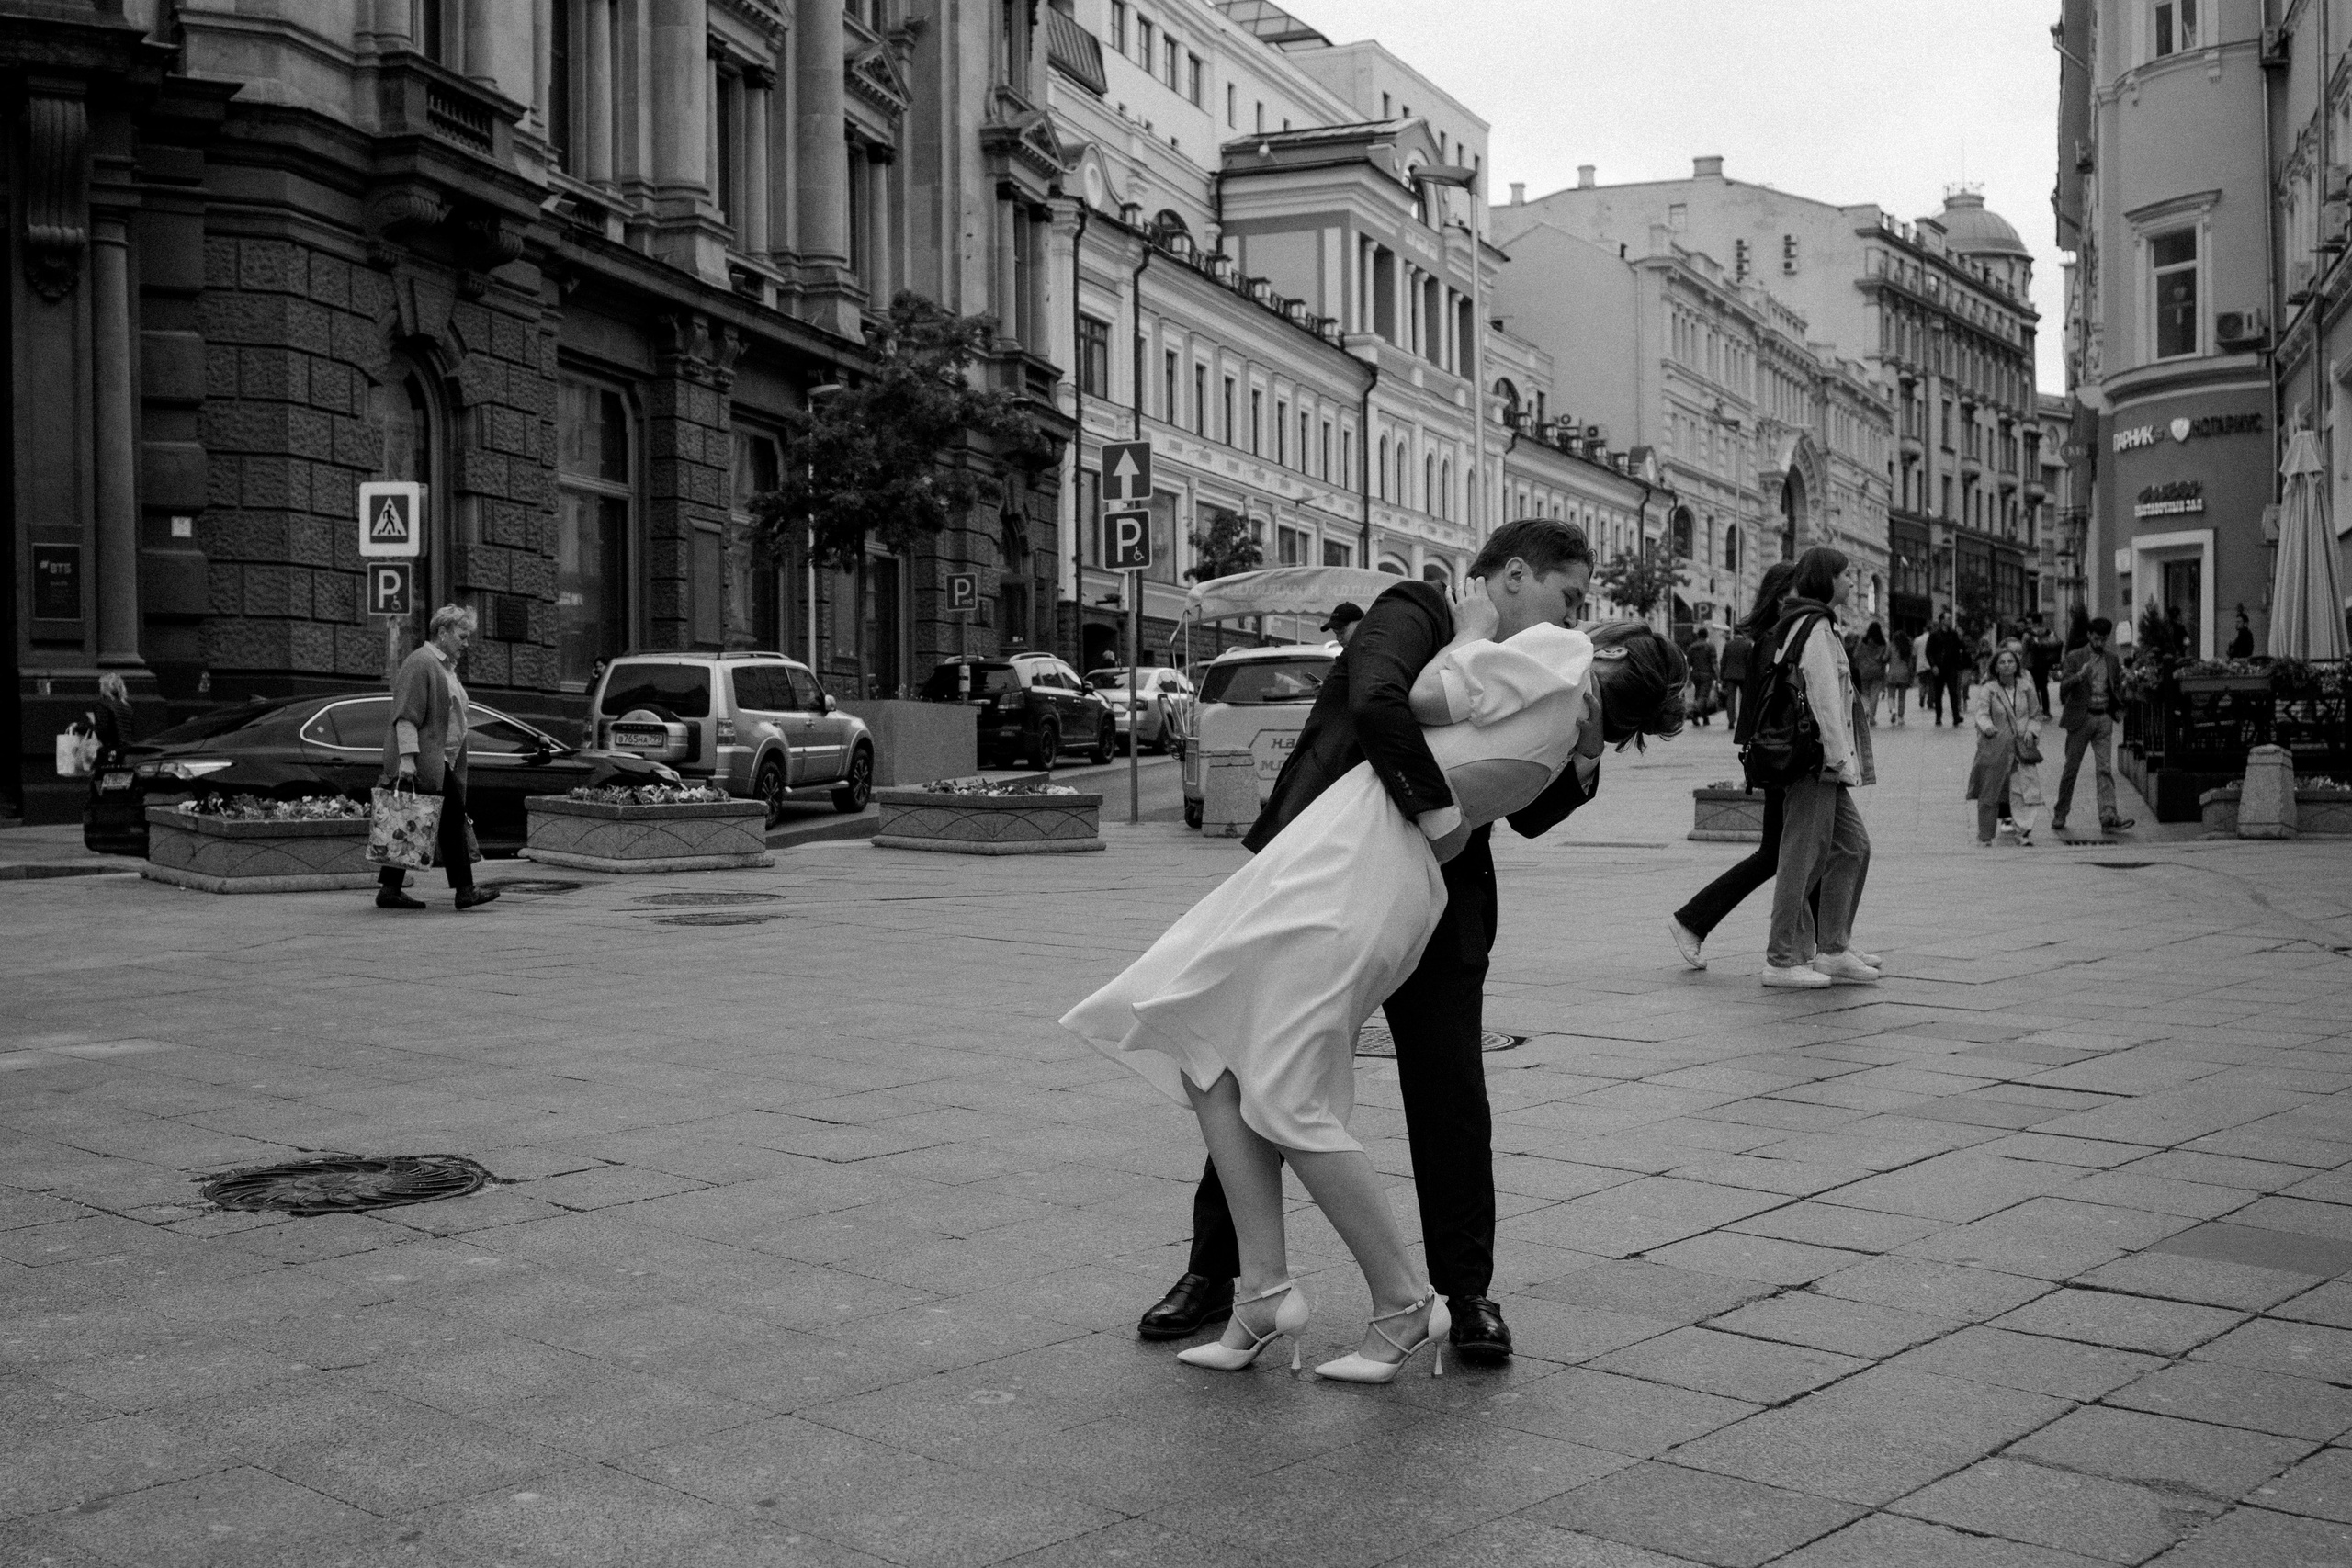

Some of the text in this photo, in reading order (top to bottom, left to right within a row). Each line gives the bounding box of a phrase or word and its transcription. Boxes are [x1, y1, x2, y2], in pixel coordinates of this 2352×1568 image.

[1116, 517, 1142, 563] P
[378, 570, 401, 609] P
[954, 578, 971, 606] P
[1698, 603, 1709, 620] P
